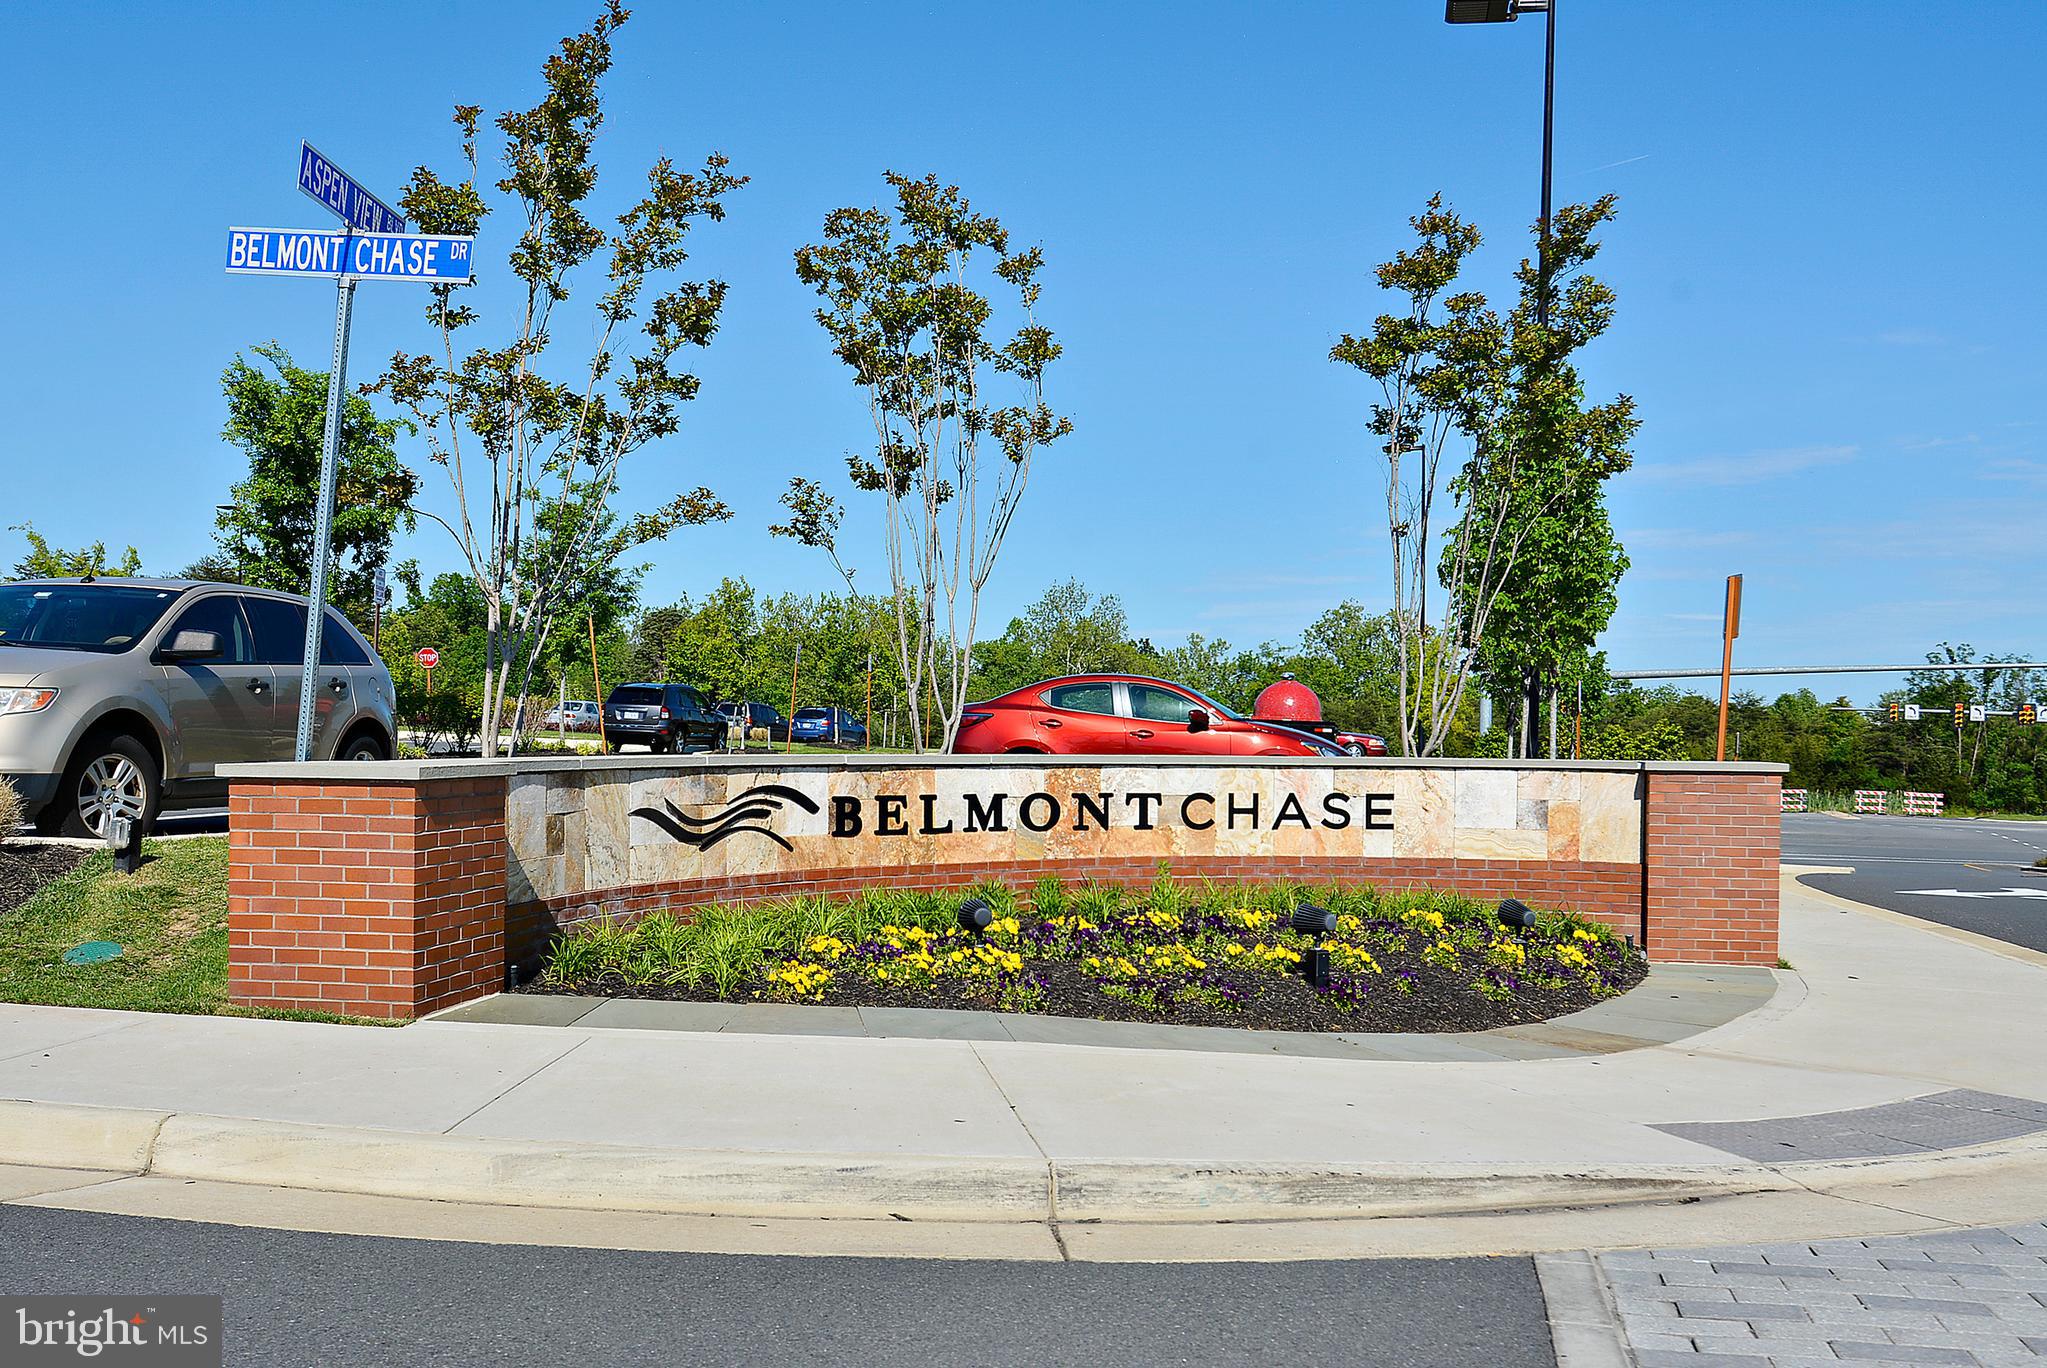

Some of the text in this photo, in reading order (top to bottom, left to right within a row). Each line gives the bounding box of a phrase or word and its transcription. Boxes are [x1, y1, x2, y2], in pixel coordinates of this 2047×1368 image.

[301, 151, 349, 214] ASPEN
[353, 188, 384, 232] VIEW
[230, 232, 468, 275] BELMONT CHASE DR
[418, 653, 437, 662] STOP
[832, 791, 1396, 838] BELMONT CHASE
